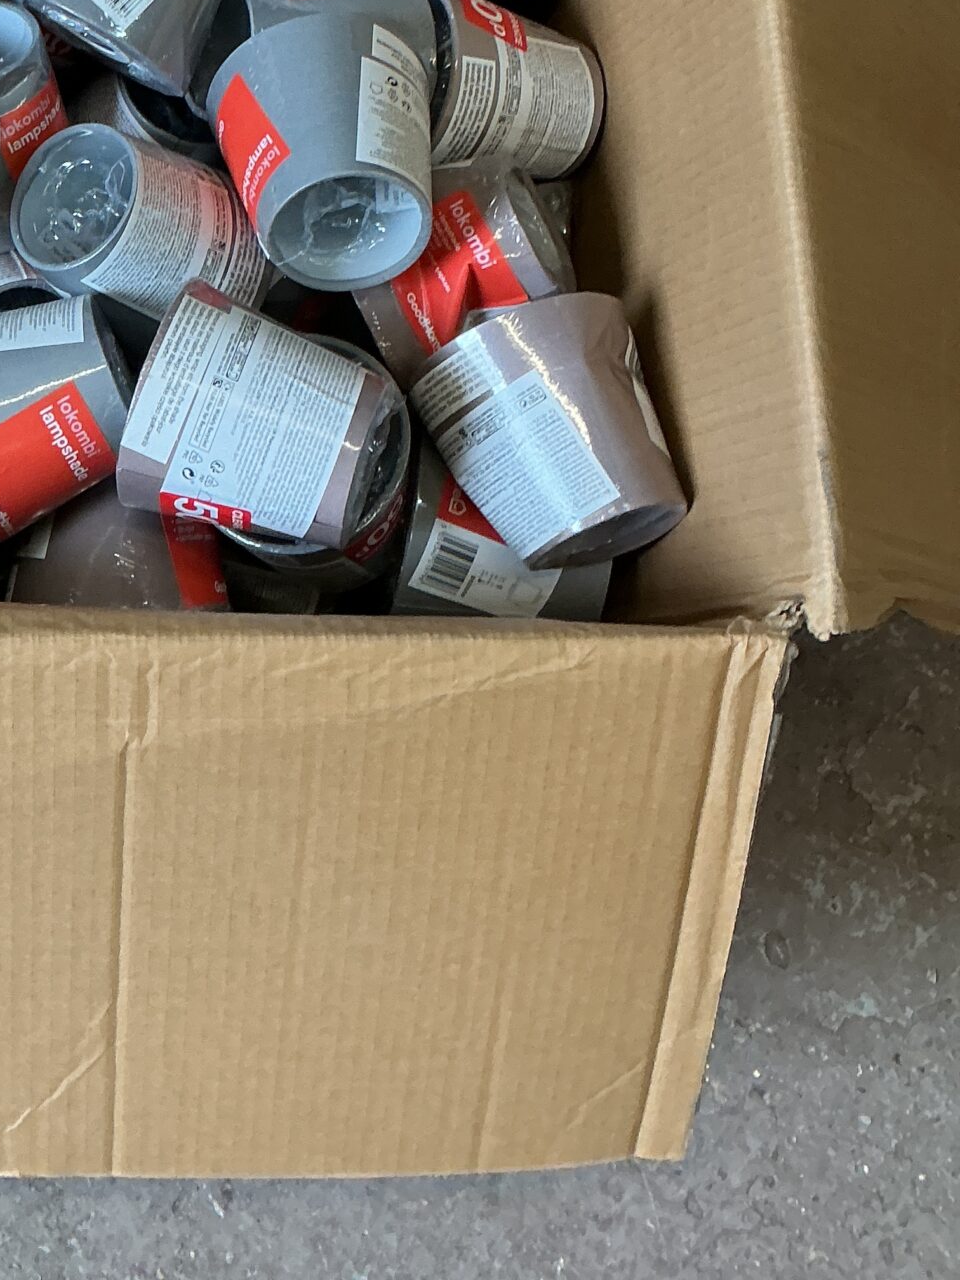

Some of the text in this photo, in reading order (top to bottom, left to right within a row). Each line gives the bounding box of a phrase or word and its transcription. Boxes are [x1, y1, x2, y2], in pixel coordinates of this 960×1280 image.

[1, 96, 52, 139] lokombi
[449, 198, 498, 270] lokombi
[38, 404, 89, 482] lampshade
[57, 395, 102, 459] lokombi
